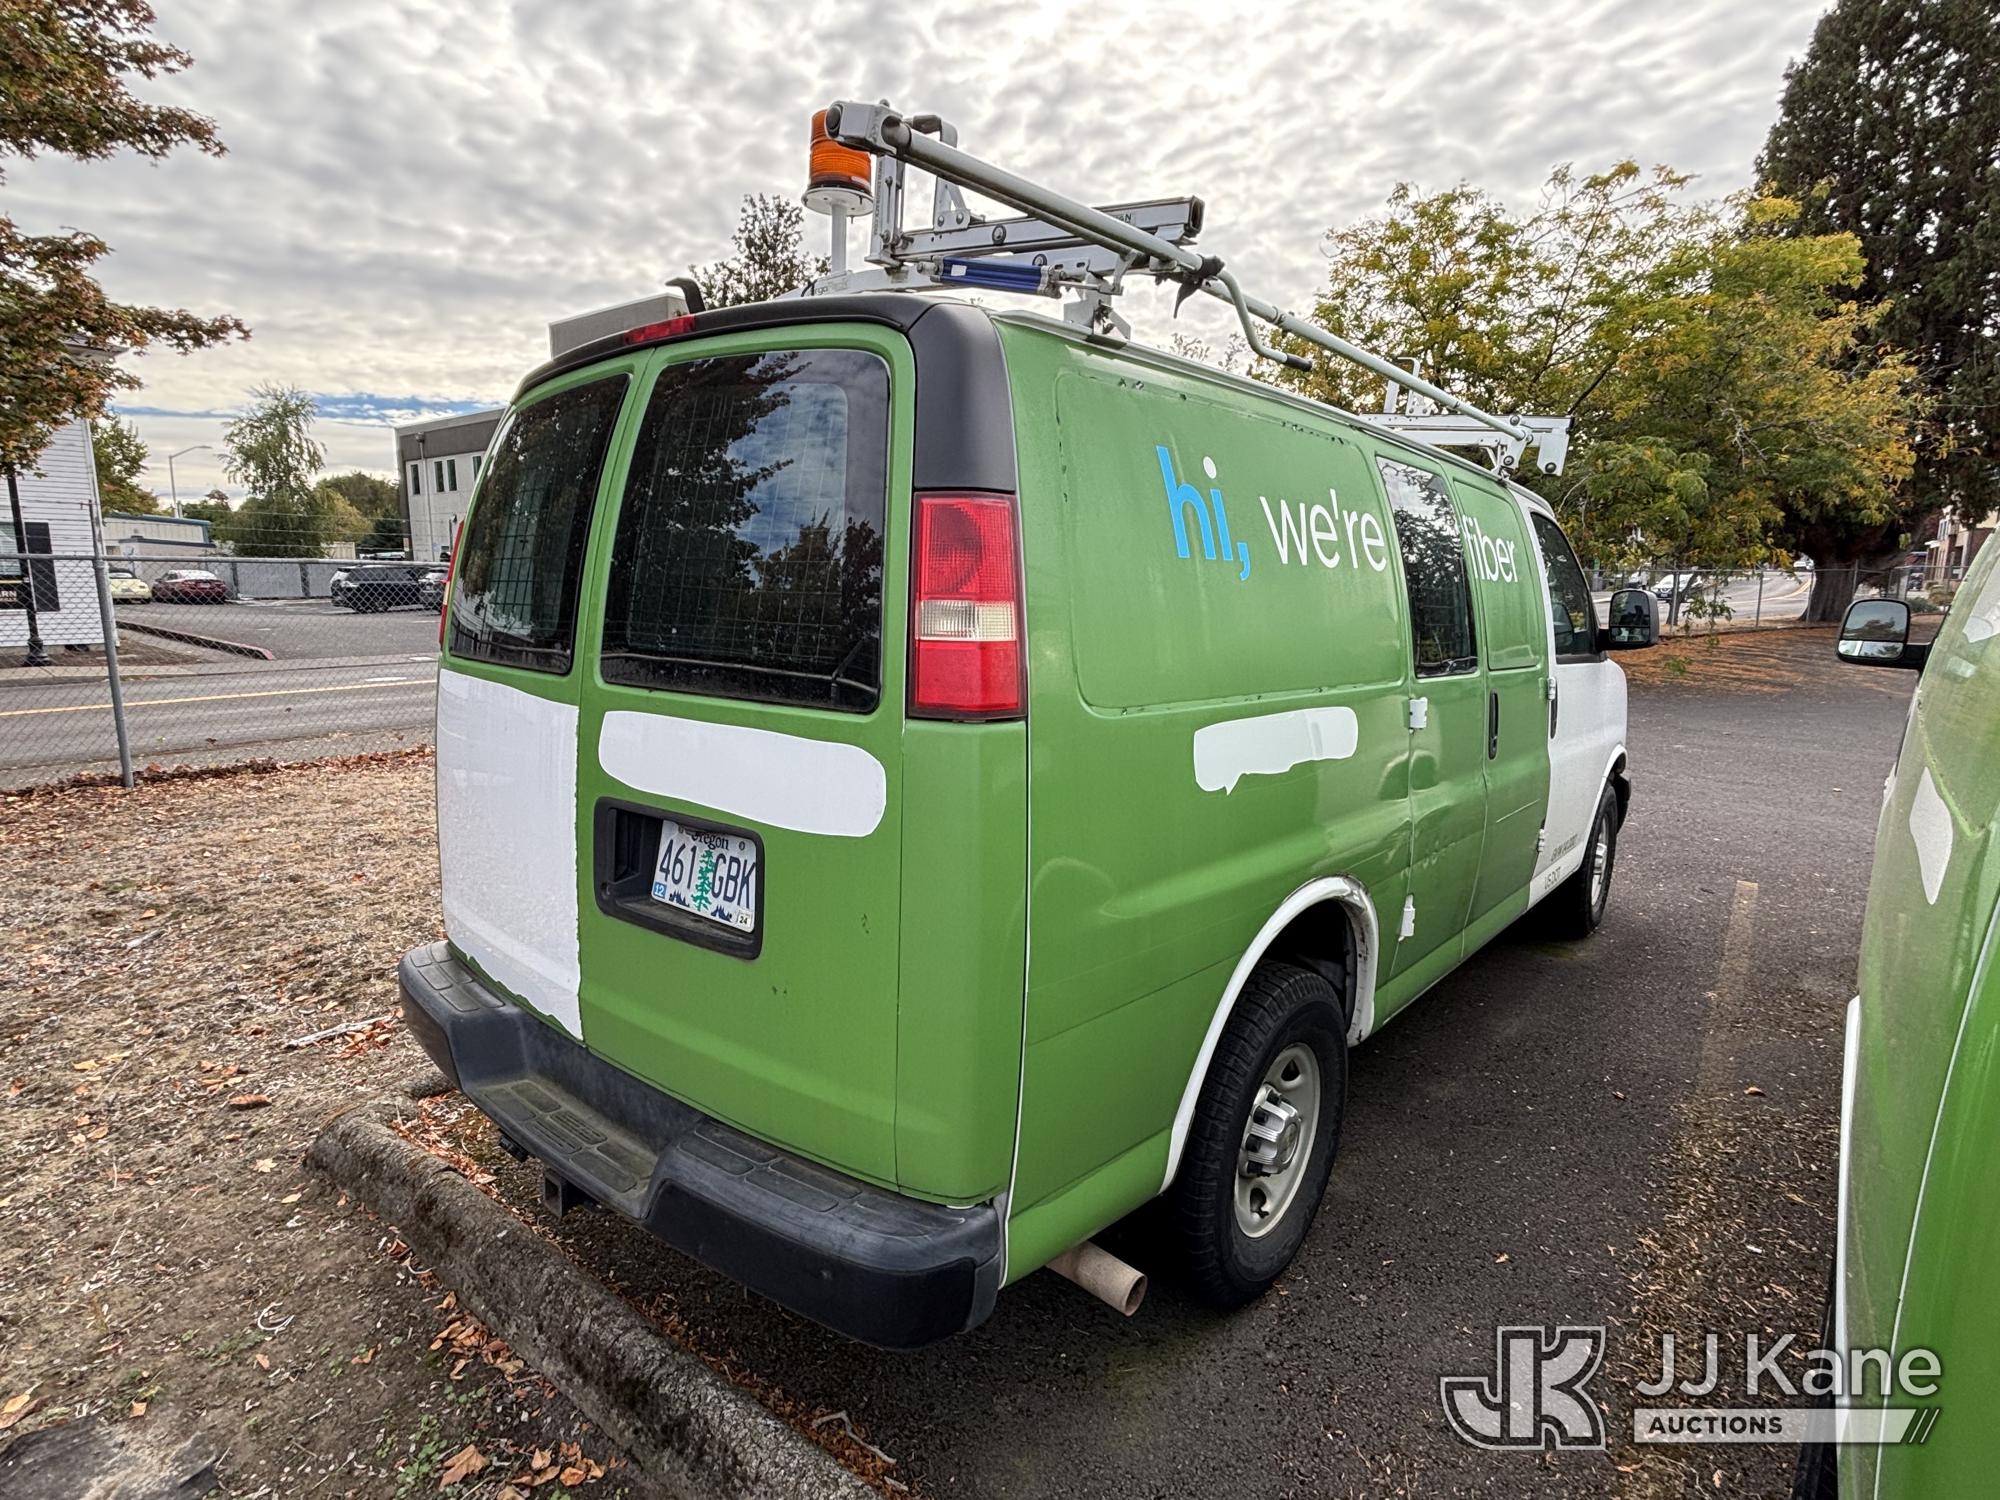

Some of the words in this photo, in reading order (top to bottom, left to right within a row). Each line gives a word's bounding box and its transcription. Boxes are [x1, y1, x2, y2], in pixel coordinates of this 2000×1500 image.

[1155, 445, 1251, 581] hi,
[1259, 488, 1388, 573] we're
[1462, 514, 1519, 584] fiber
[659, 838, 698, 890] 461
[711, 853, 757, 910] GBK
[739, 915, 748, 925] 24
